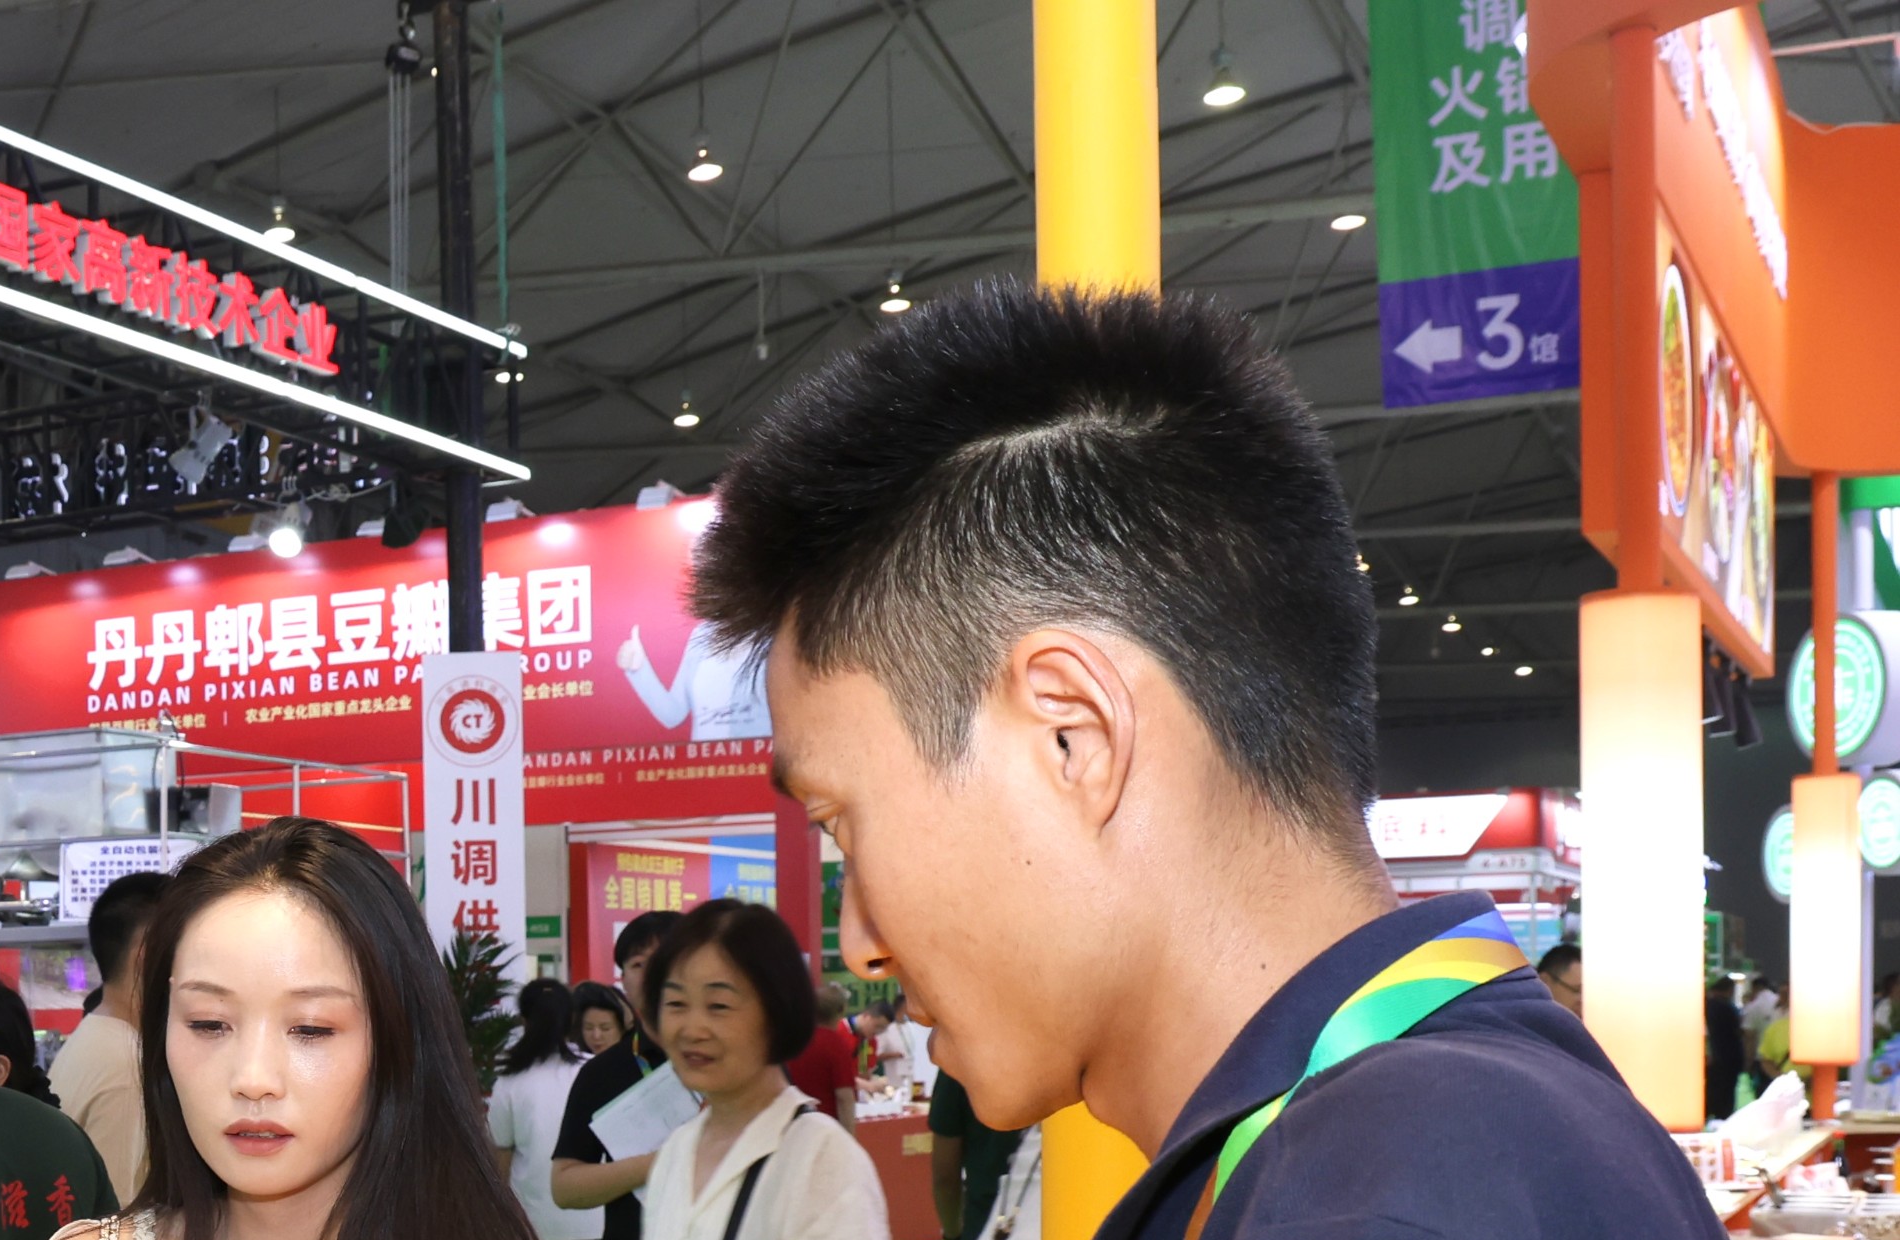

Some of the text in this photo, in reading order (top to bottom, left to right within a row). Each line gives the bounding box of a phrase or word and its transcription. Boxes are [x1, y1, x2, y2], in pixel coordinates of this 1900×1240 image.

[87, 564, 592, 691] 丹丹郫县豆瓣集团
[87, 686, 191, 713] DANDAN
[204, 675, 295, 702] PIXIAN
[309, 666, 379, 692] BEAN
[518, 648, 593, 673] ROUP
[461, 713, 484, 729] CT
[523, 752, 592, 768] ANDAN
[603, 745, 676, 763] PIXIAN
[687, 740, 743, 758] BEAN
